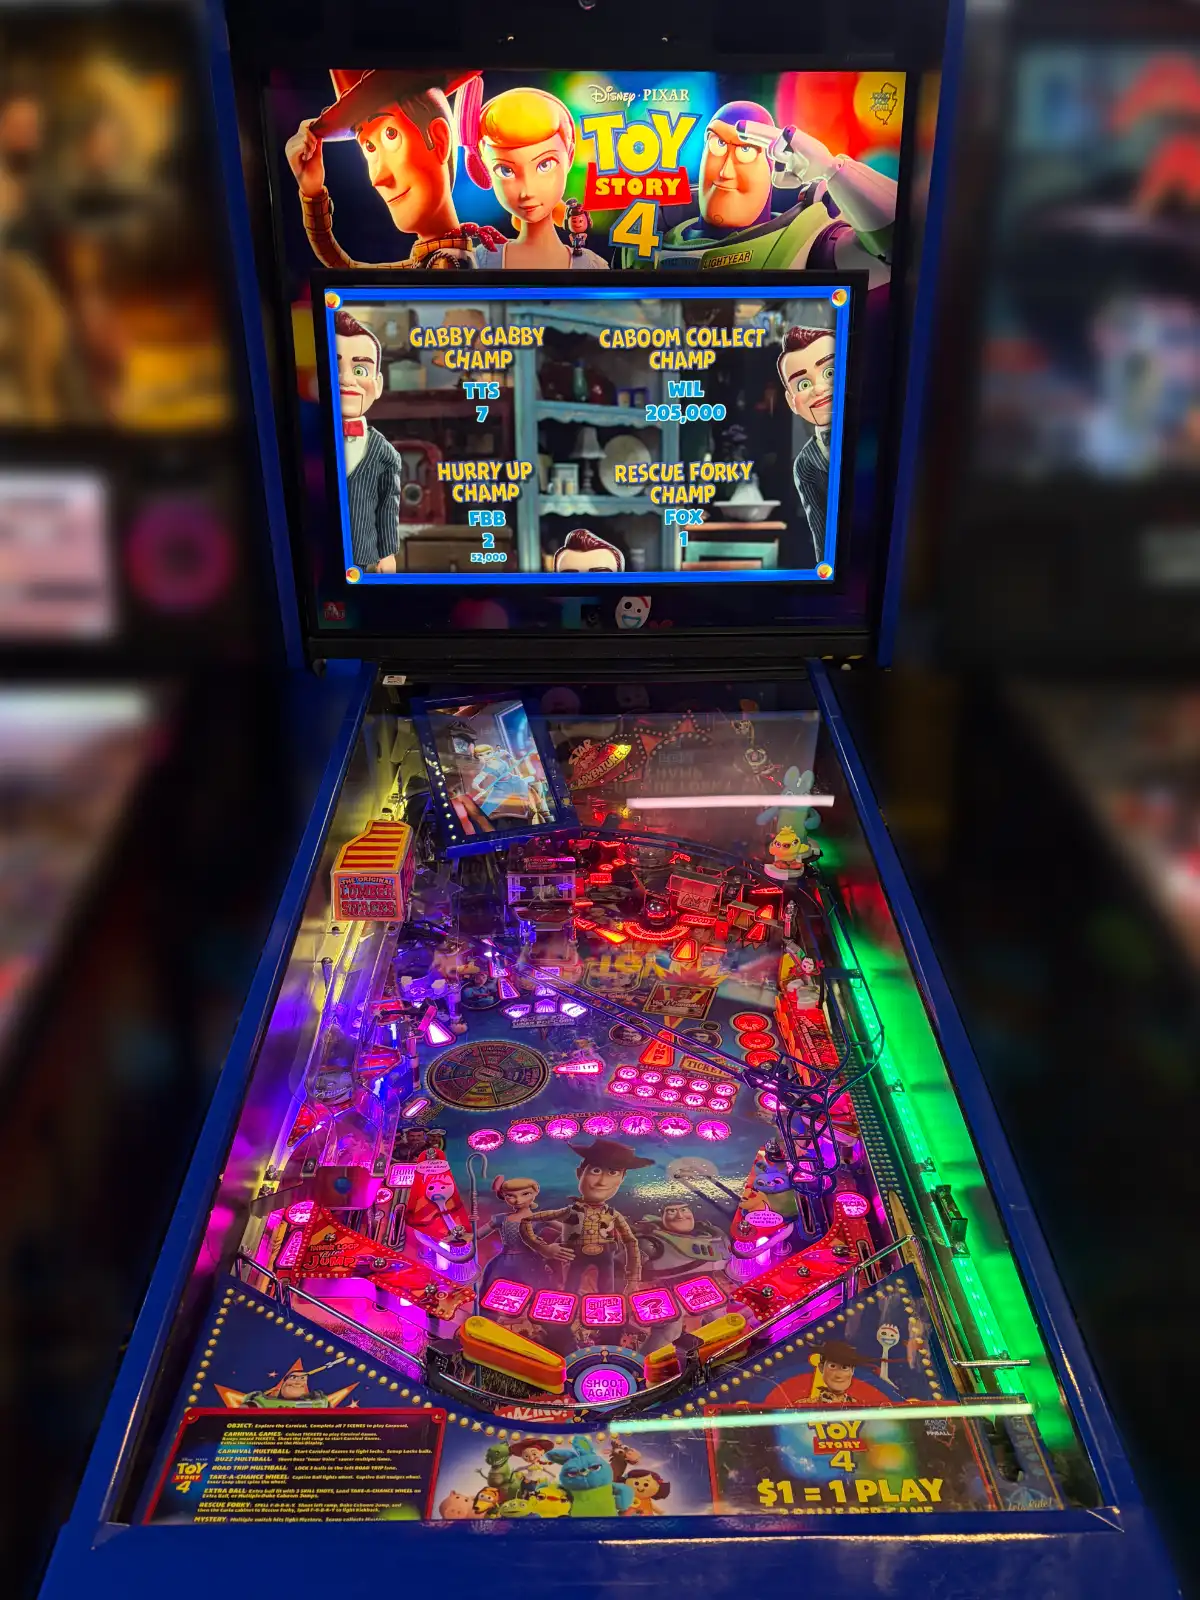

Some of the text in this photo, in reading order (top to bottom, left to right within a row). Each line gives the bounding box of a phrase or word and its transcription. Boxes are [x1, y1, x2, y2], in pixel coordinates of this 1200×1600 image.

[588, 84, 690, 107] Disney PIXAR
[580, 109, 703, 176] TOY
[595, 178, 681, 196] STORY
[608, 199, 663, 262] 4
[703, 251, 750, 268] LIGHTYEAR
[410, 326, 546, 348] GABBY GABBY
[599, 328, 766, 349] CABOOM COLLECT
[444, 348, 513, 370] CHAMP
[649, 350, 716, 371] CHAMP
[464, 382, 500, 400] TTS
[668, 380, 704, 399] WIL
[476, 405, 489, 423] 7
[645, 404, 726, 424] 205,000
[437, 462, 533, 483] HURRY UP
[614, 461, 754, 483] RESCUE FORKY
[452, 484, 520, 504] CHAMP
[650, 484, 716, 505] CHAMP
[468, 511, 506, 528] FBB
[664, 509, 704, 526] FOX
[481, 532, 495, 549] 2
[678, 532, 688, 548] 1
[470, 553, 508, 564] 52,000
[569, 739, 592, 765] STAR
[340, 884, 394, 899] LUMBER
[342, 901, 394, 916] SNACKS
[303, 1256, 355, 1270] JUMP
[494, 1288, 526, 1297] SUPER
[588, 1299, 618, 1308] SUPER
[588, 1389, 624, 1397] AGAIN
[808, 1420, 862, 1440] TOY
[818, 1441, 861, 1449] STORY
[177, 1462, 208, 1474] TOY
[830, 1450, 856, 1472] 4
[176, 1480, 192, 1494] 4
[757, 1478, 794, 1506] $1
[828, 1480, 846, 1503] 1
[854, 1478, 944, 1502] PLAY
